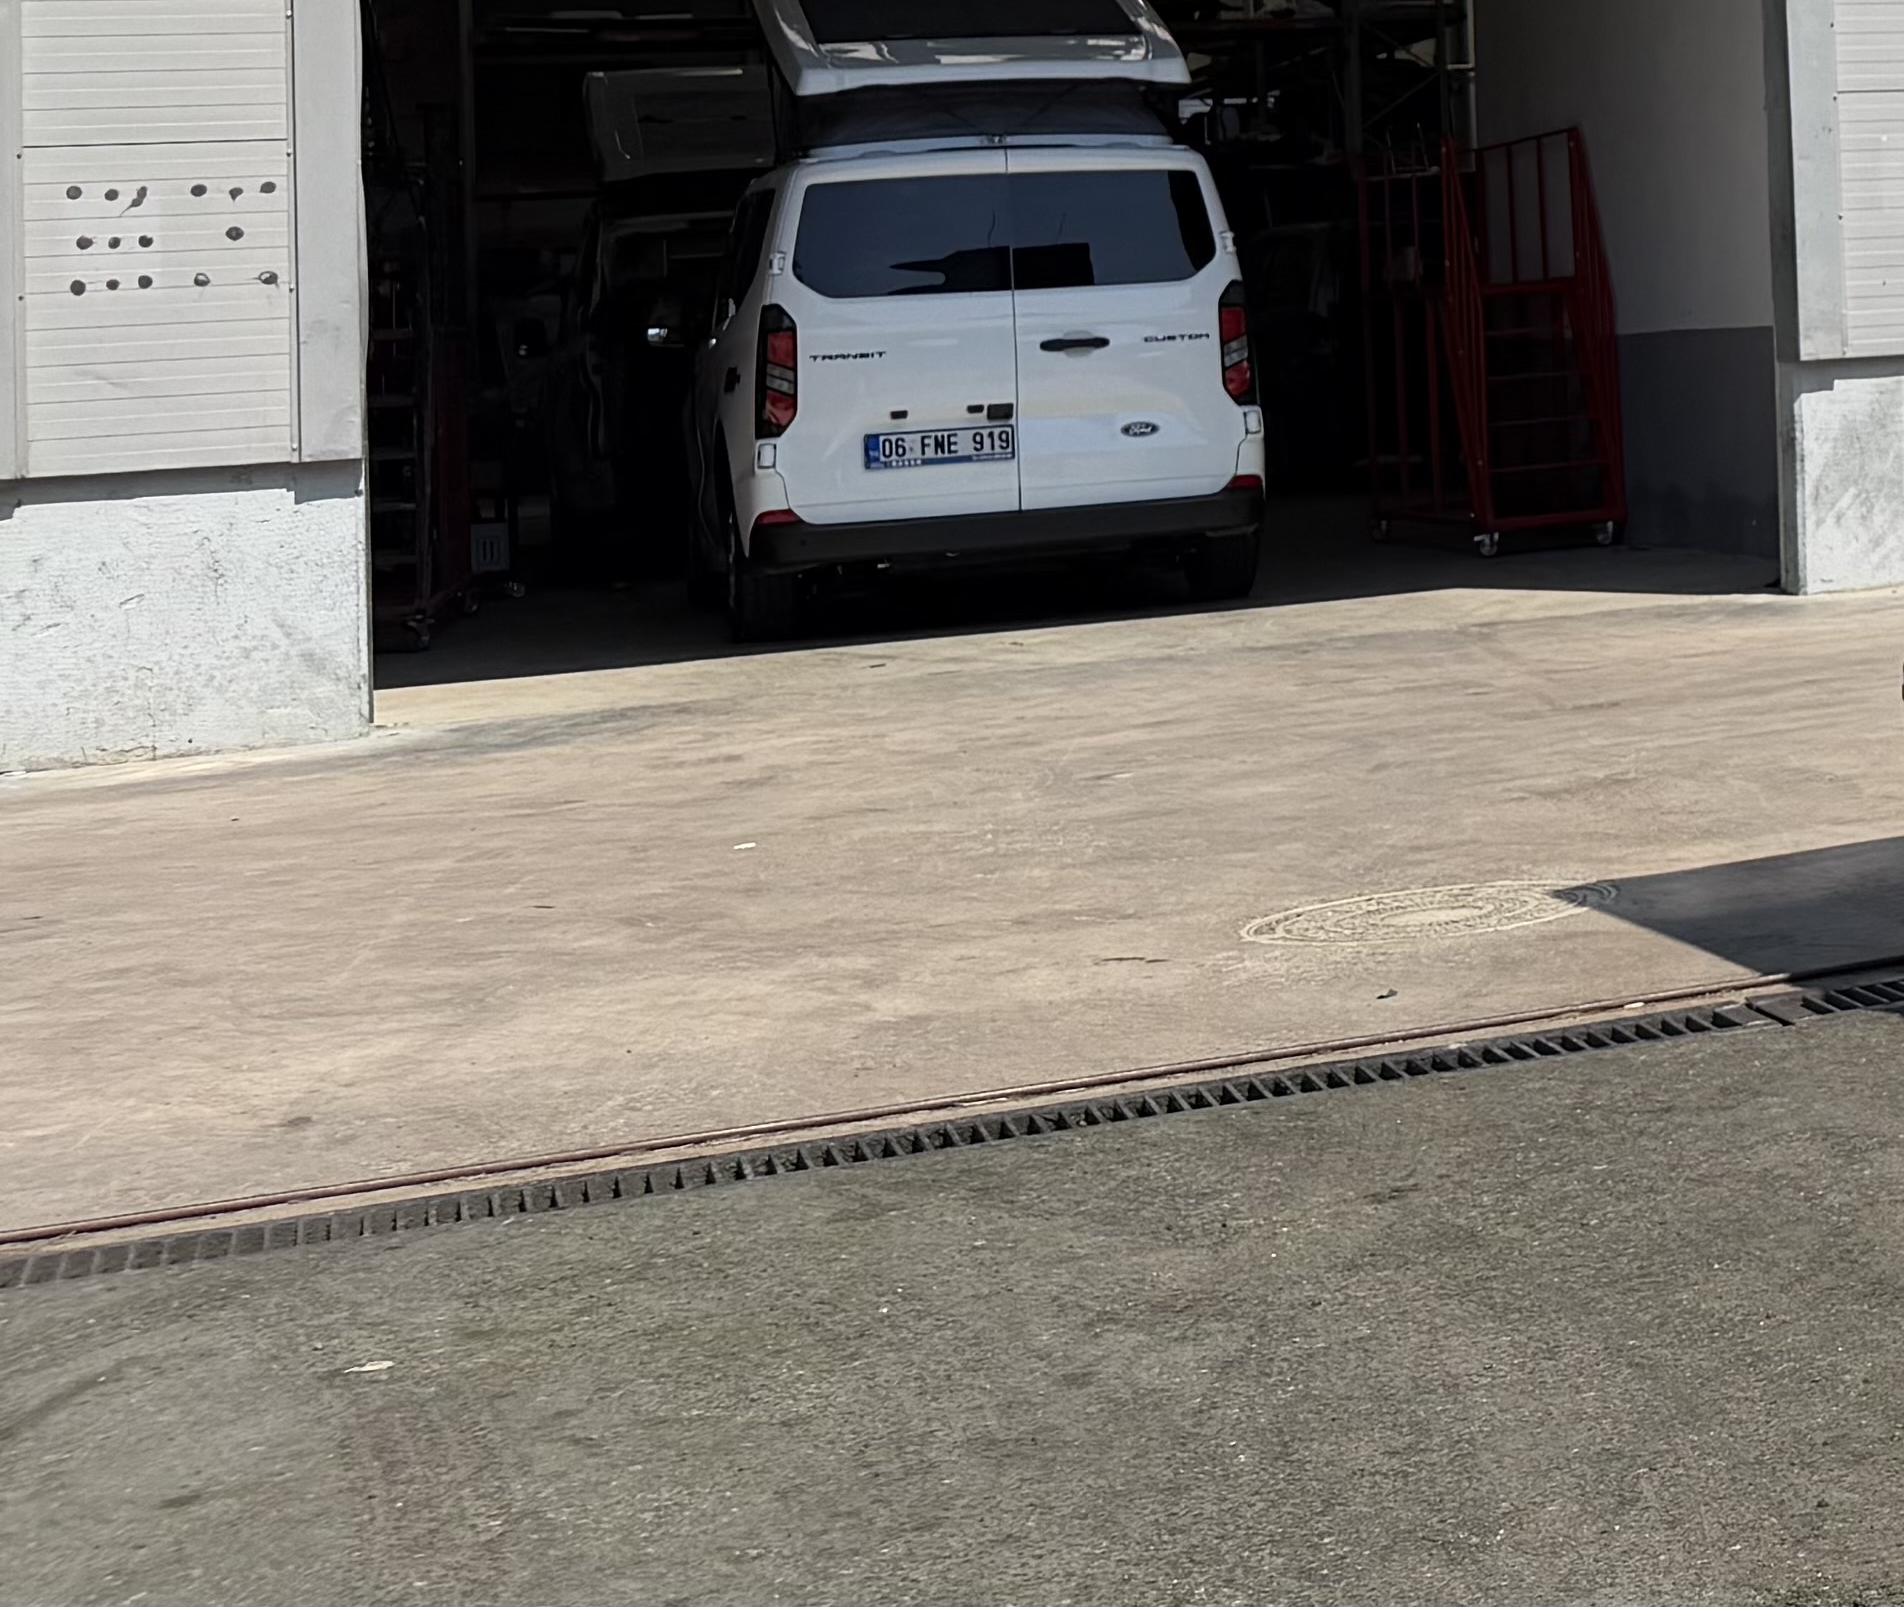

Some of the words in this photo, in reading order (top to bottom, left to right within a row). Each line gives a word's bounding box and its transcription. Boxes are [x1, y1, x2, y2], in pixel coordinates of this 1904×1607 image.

[808, 350, 887, 363] TRANSIT
[881, 437, 907, 459] 06
[920, 433, 959, 457] FNE
[972, 430, 1011, 453] 919
